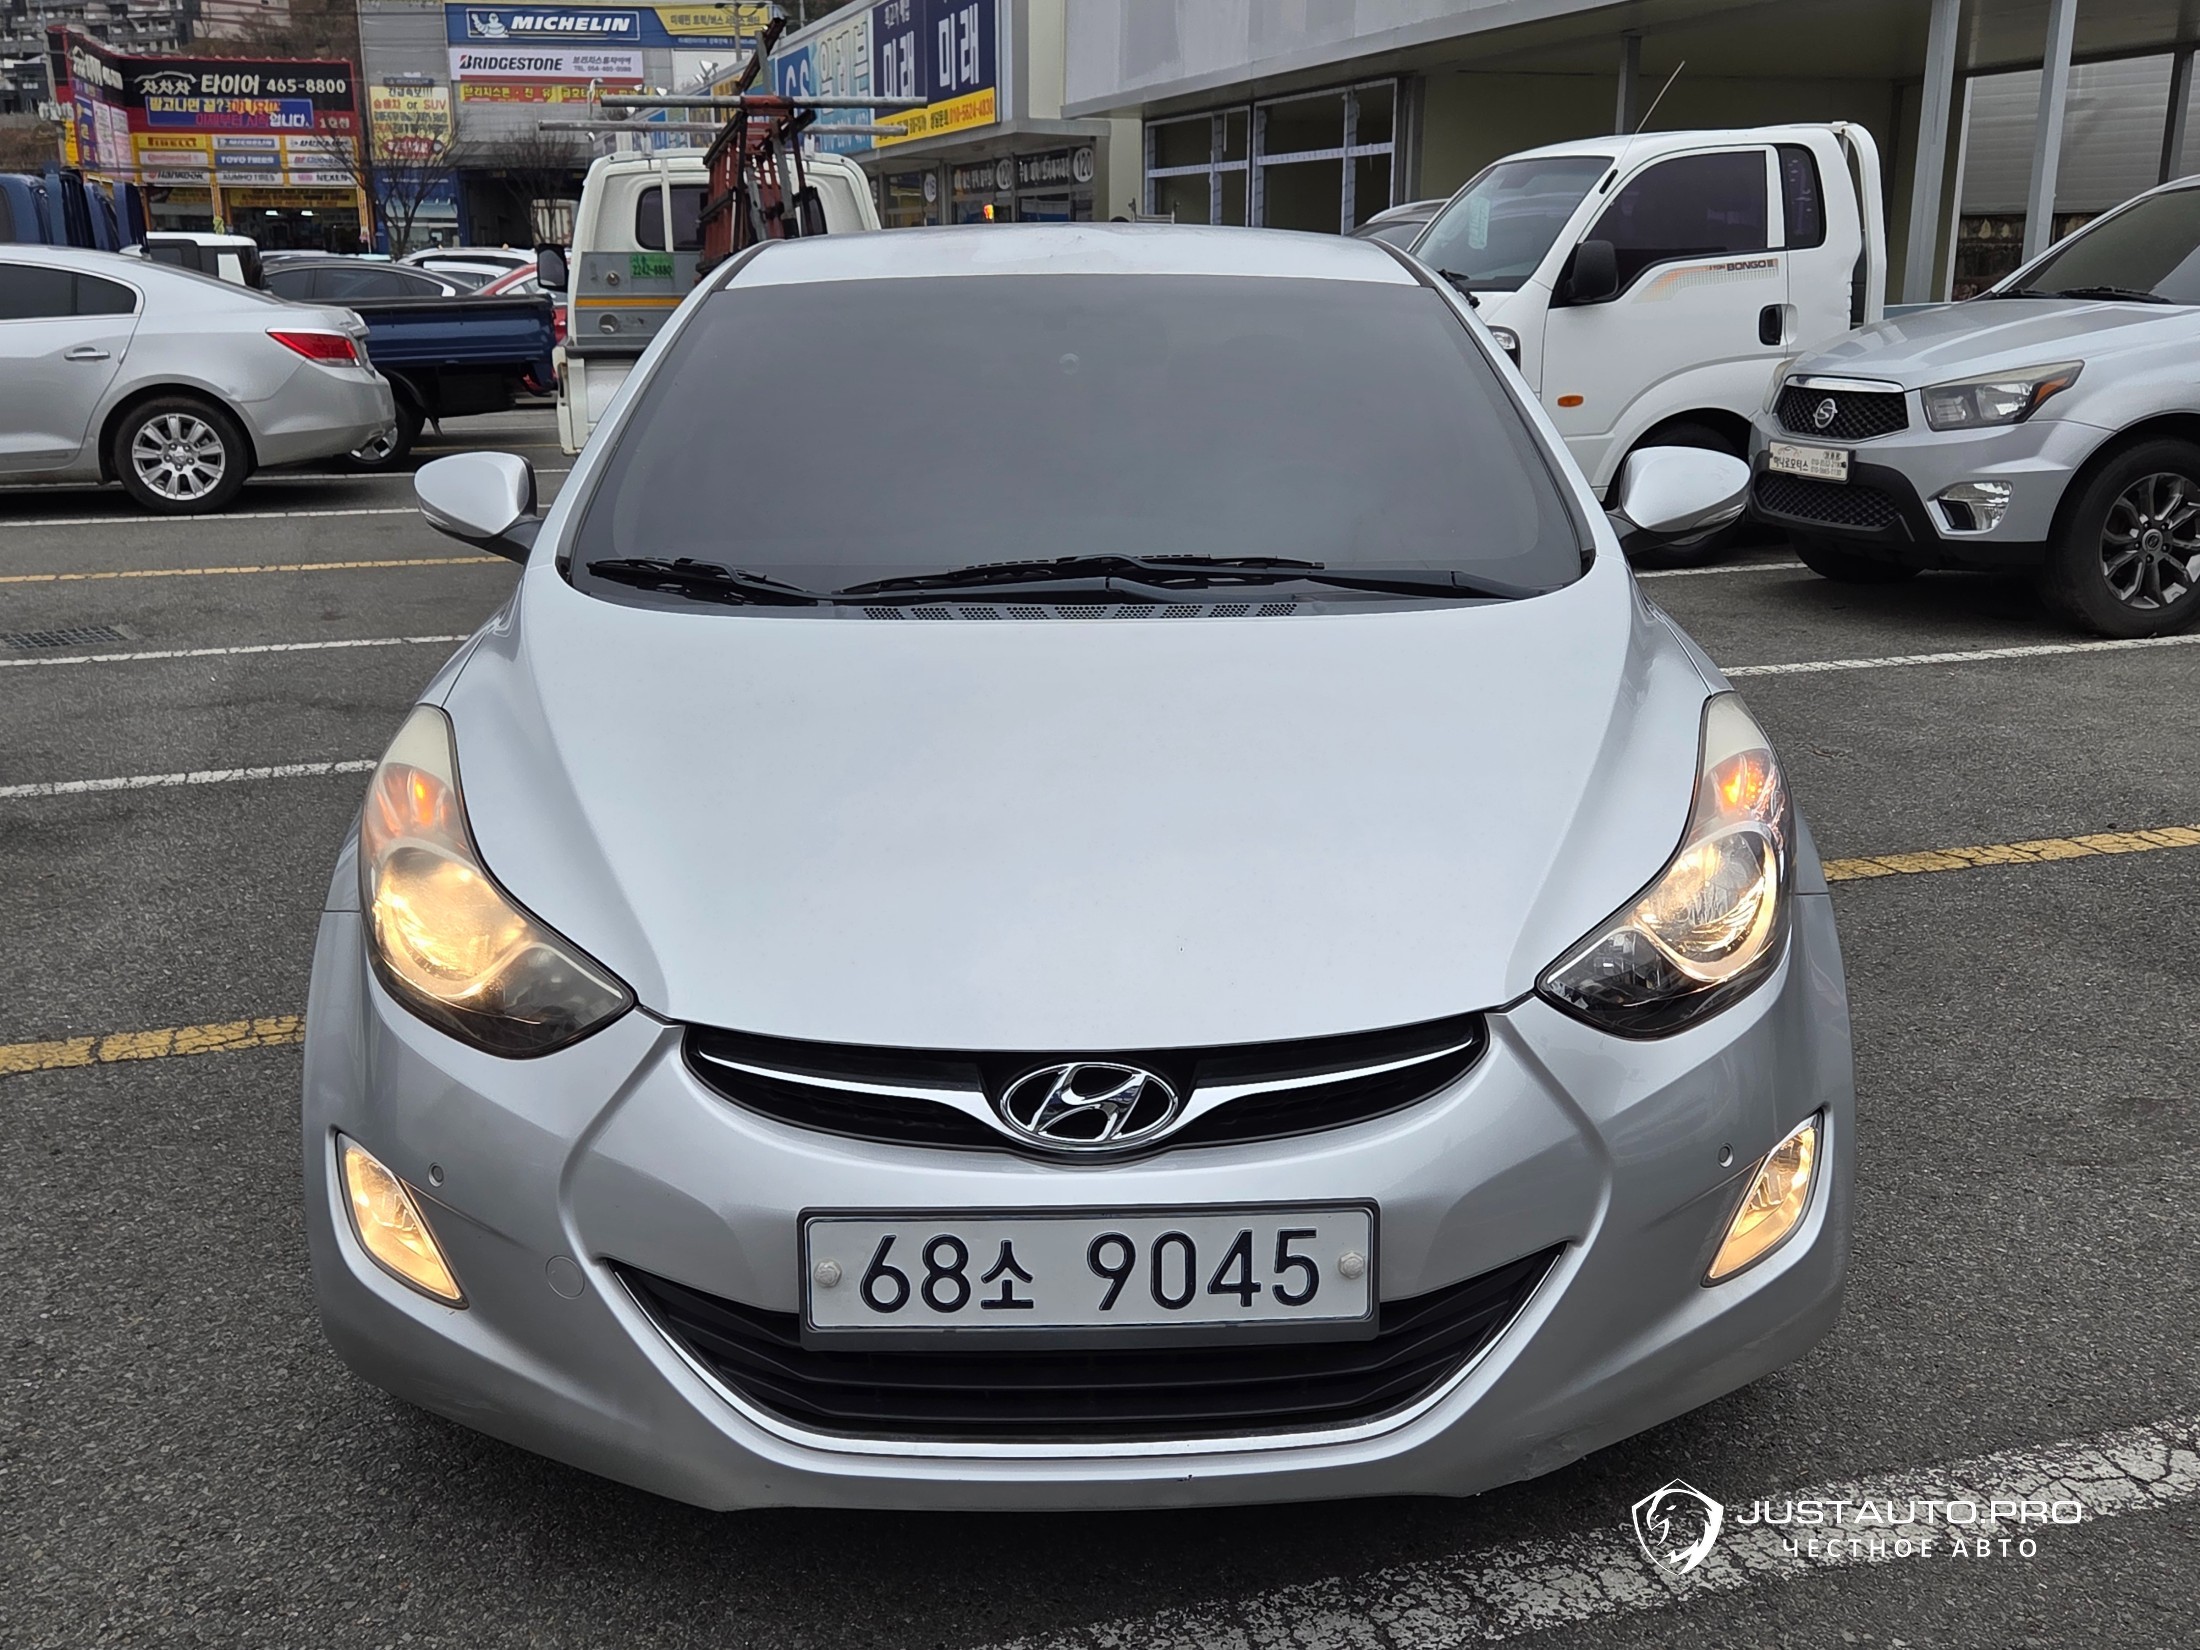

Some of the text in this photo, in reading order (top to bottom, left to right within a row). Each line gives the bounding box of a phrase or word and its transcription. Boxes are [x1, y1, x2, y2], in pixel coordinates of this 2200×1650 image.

[511, 16, 630, 32] MICHELIN
[938, 3, 979, 91] 미래
[459, 55, 563, 71] BRIDGESTONE
[201, 74, 260, 95] 타이어
[266, 78, 346, 94] 465-8800
[407, 101, 417, 110] or
[424, 99, 447, 110] SUV
[1726, 260, 1766, 271] BONGO
[860, 1228, 1319, 1313] 68소 9045
